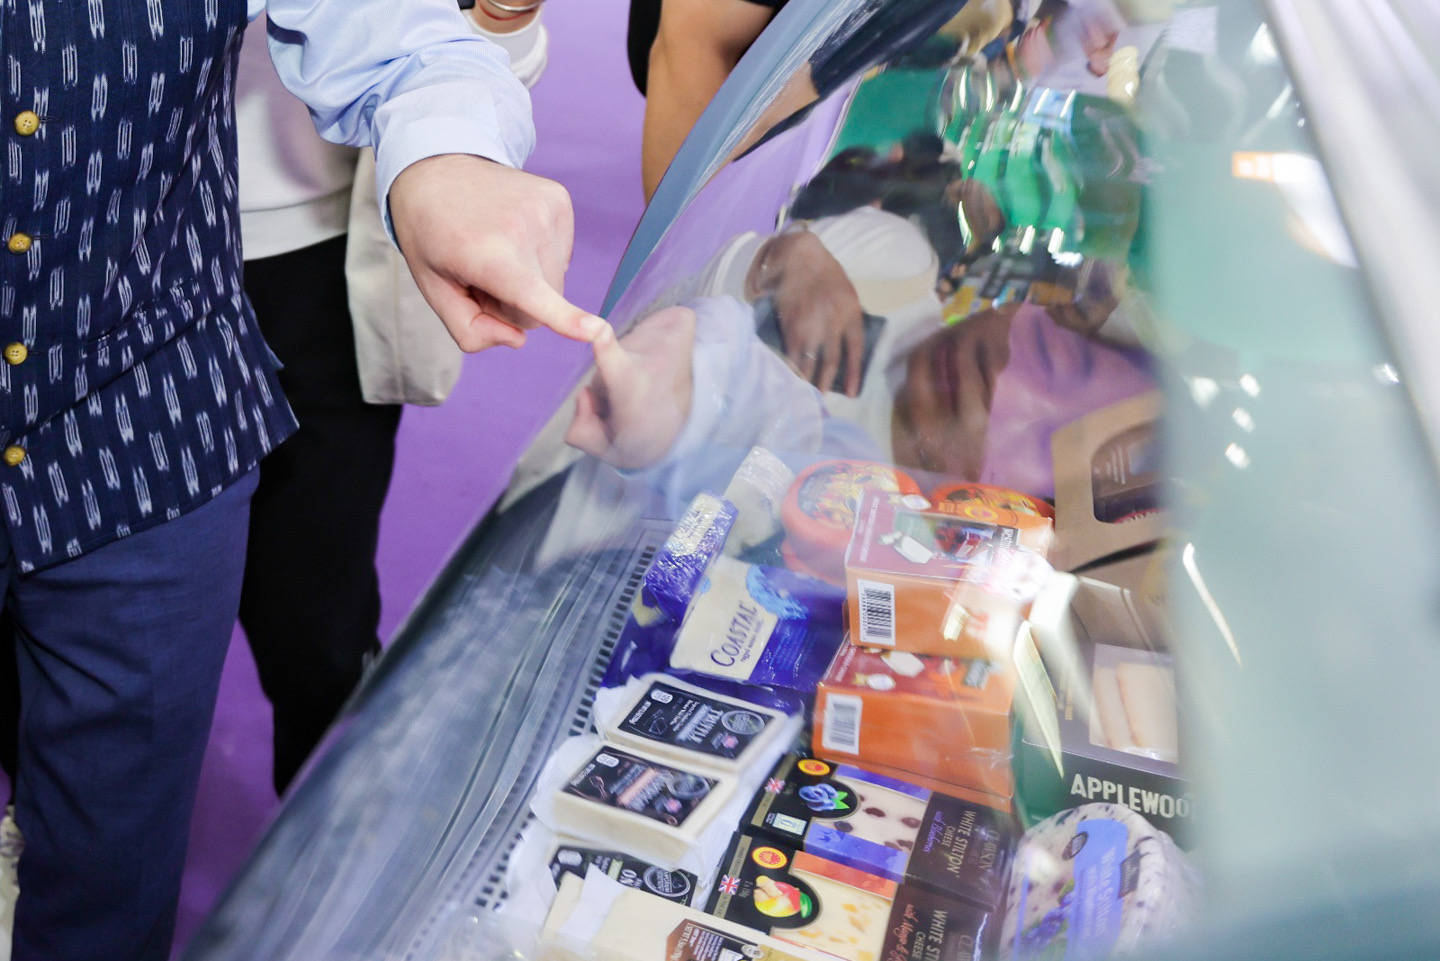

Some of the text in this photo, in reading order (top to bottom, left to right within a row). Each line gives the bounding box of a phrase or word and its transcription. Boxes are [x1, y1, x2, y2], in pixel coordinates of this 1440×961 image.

[941, 825, 956, 848] CHEESE
[947, 810, 977, 874] WHITE STILTON
[928, 909, 949, 945] WHITE
[911, 930, 927, 959] CHEESE
